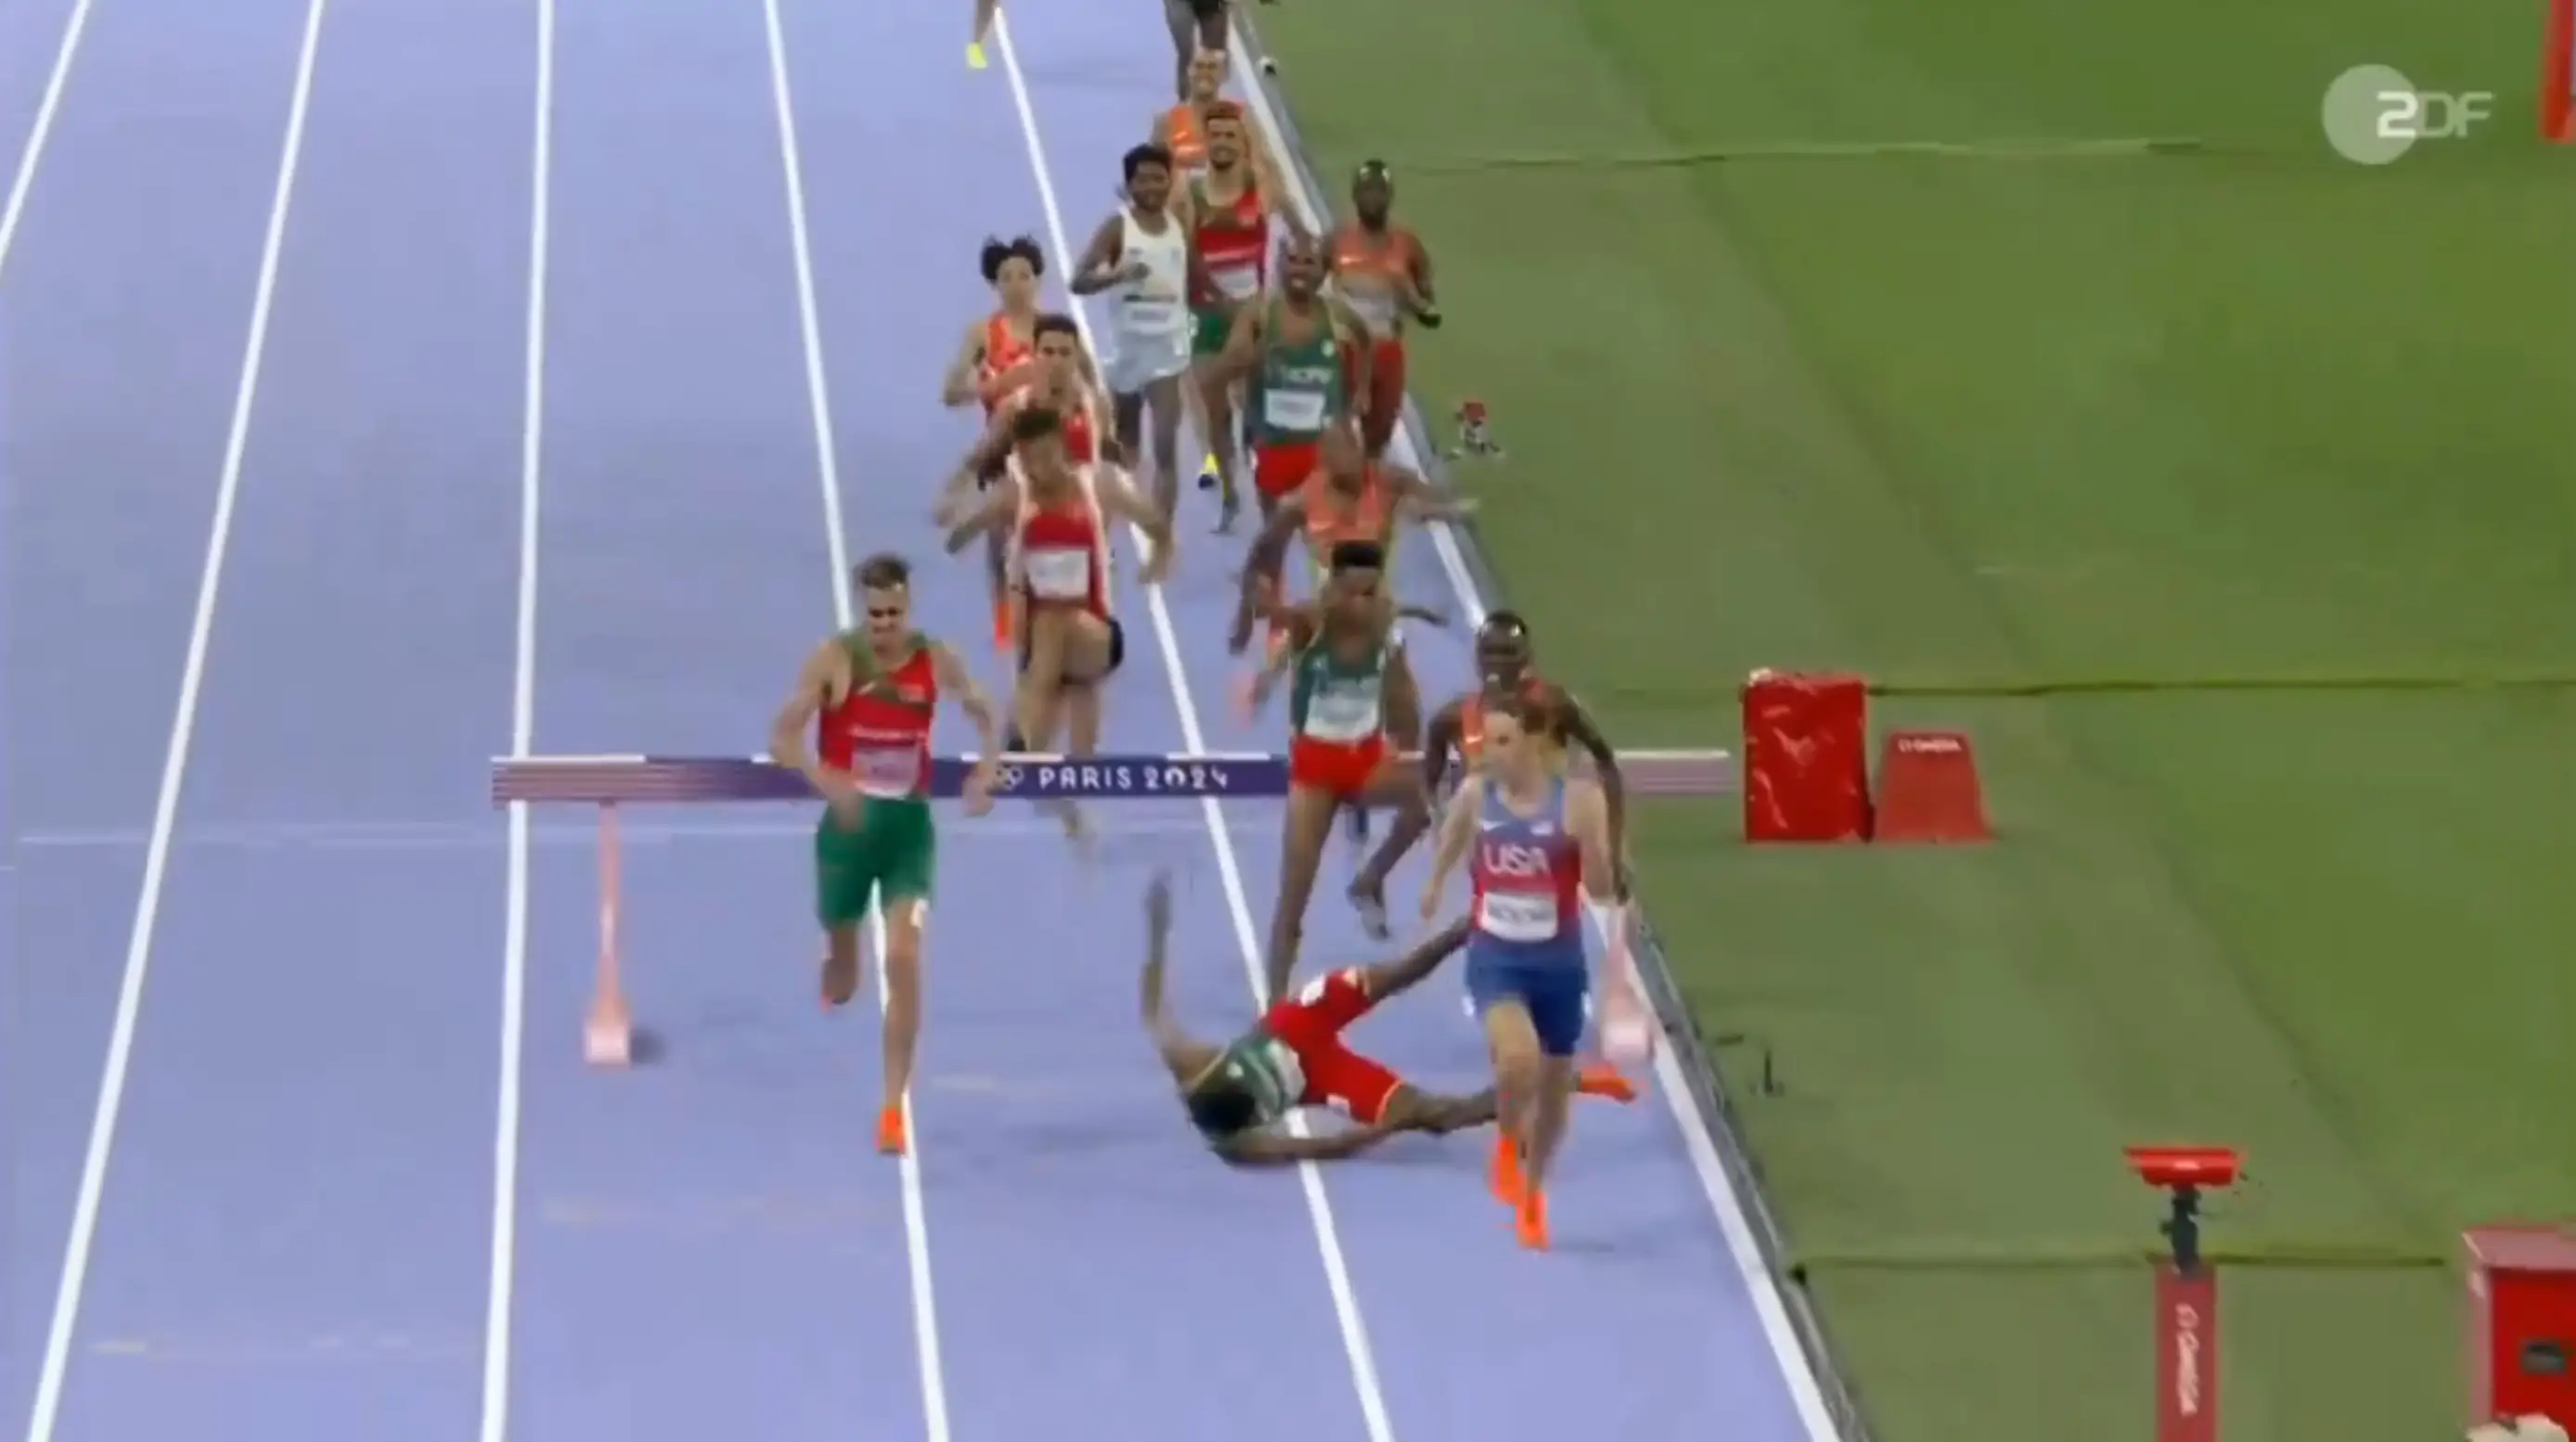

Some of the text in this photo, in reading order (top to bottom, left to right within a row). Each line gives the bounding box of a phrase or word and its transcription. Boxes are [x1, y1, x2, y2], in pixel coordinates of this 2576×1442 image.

[1038, 766, 1229, 789] PARIS 2024
[1483, 843, 1553, 876] USA
